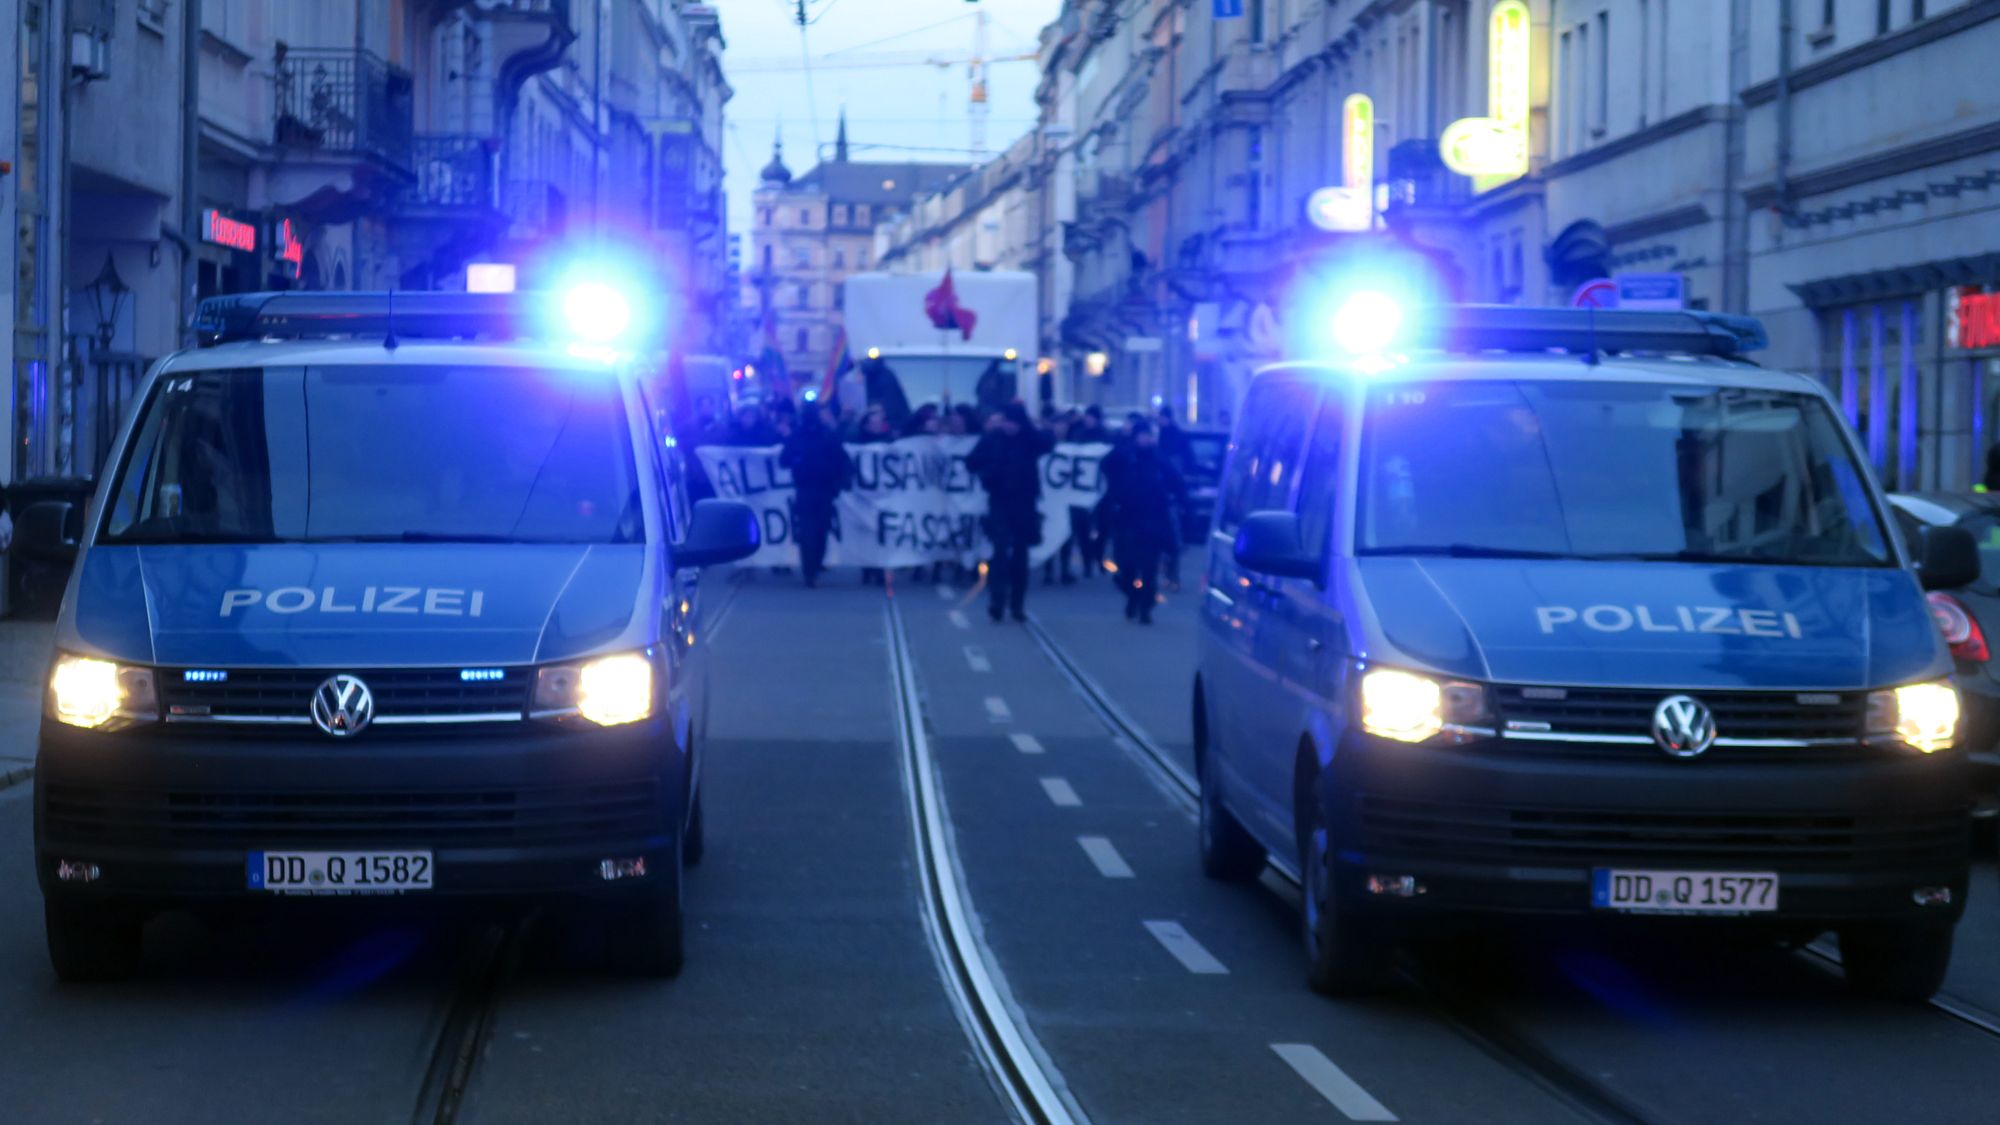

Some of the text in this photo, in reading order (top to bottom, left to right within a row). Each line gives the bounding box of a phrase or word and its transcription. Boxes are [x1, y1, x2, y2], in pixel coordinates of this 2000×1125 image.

[219, 586, 484, 617] POLIZEI
[1535, 604, 1801, 639] POLIZEI
[267, 856, 429, 884] DD Q 1582
[1613, 875, 1774, 905] DD Q 1577
